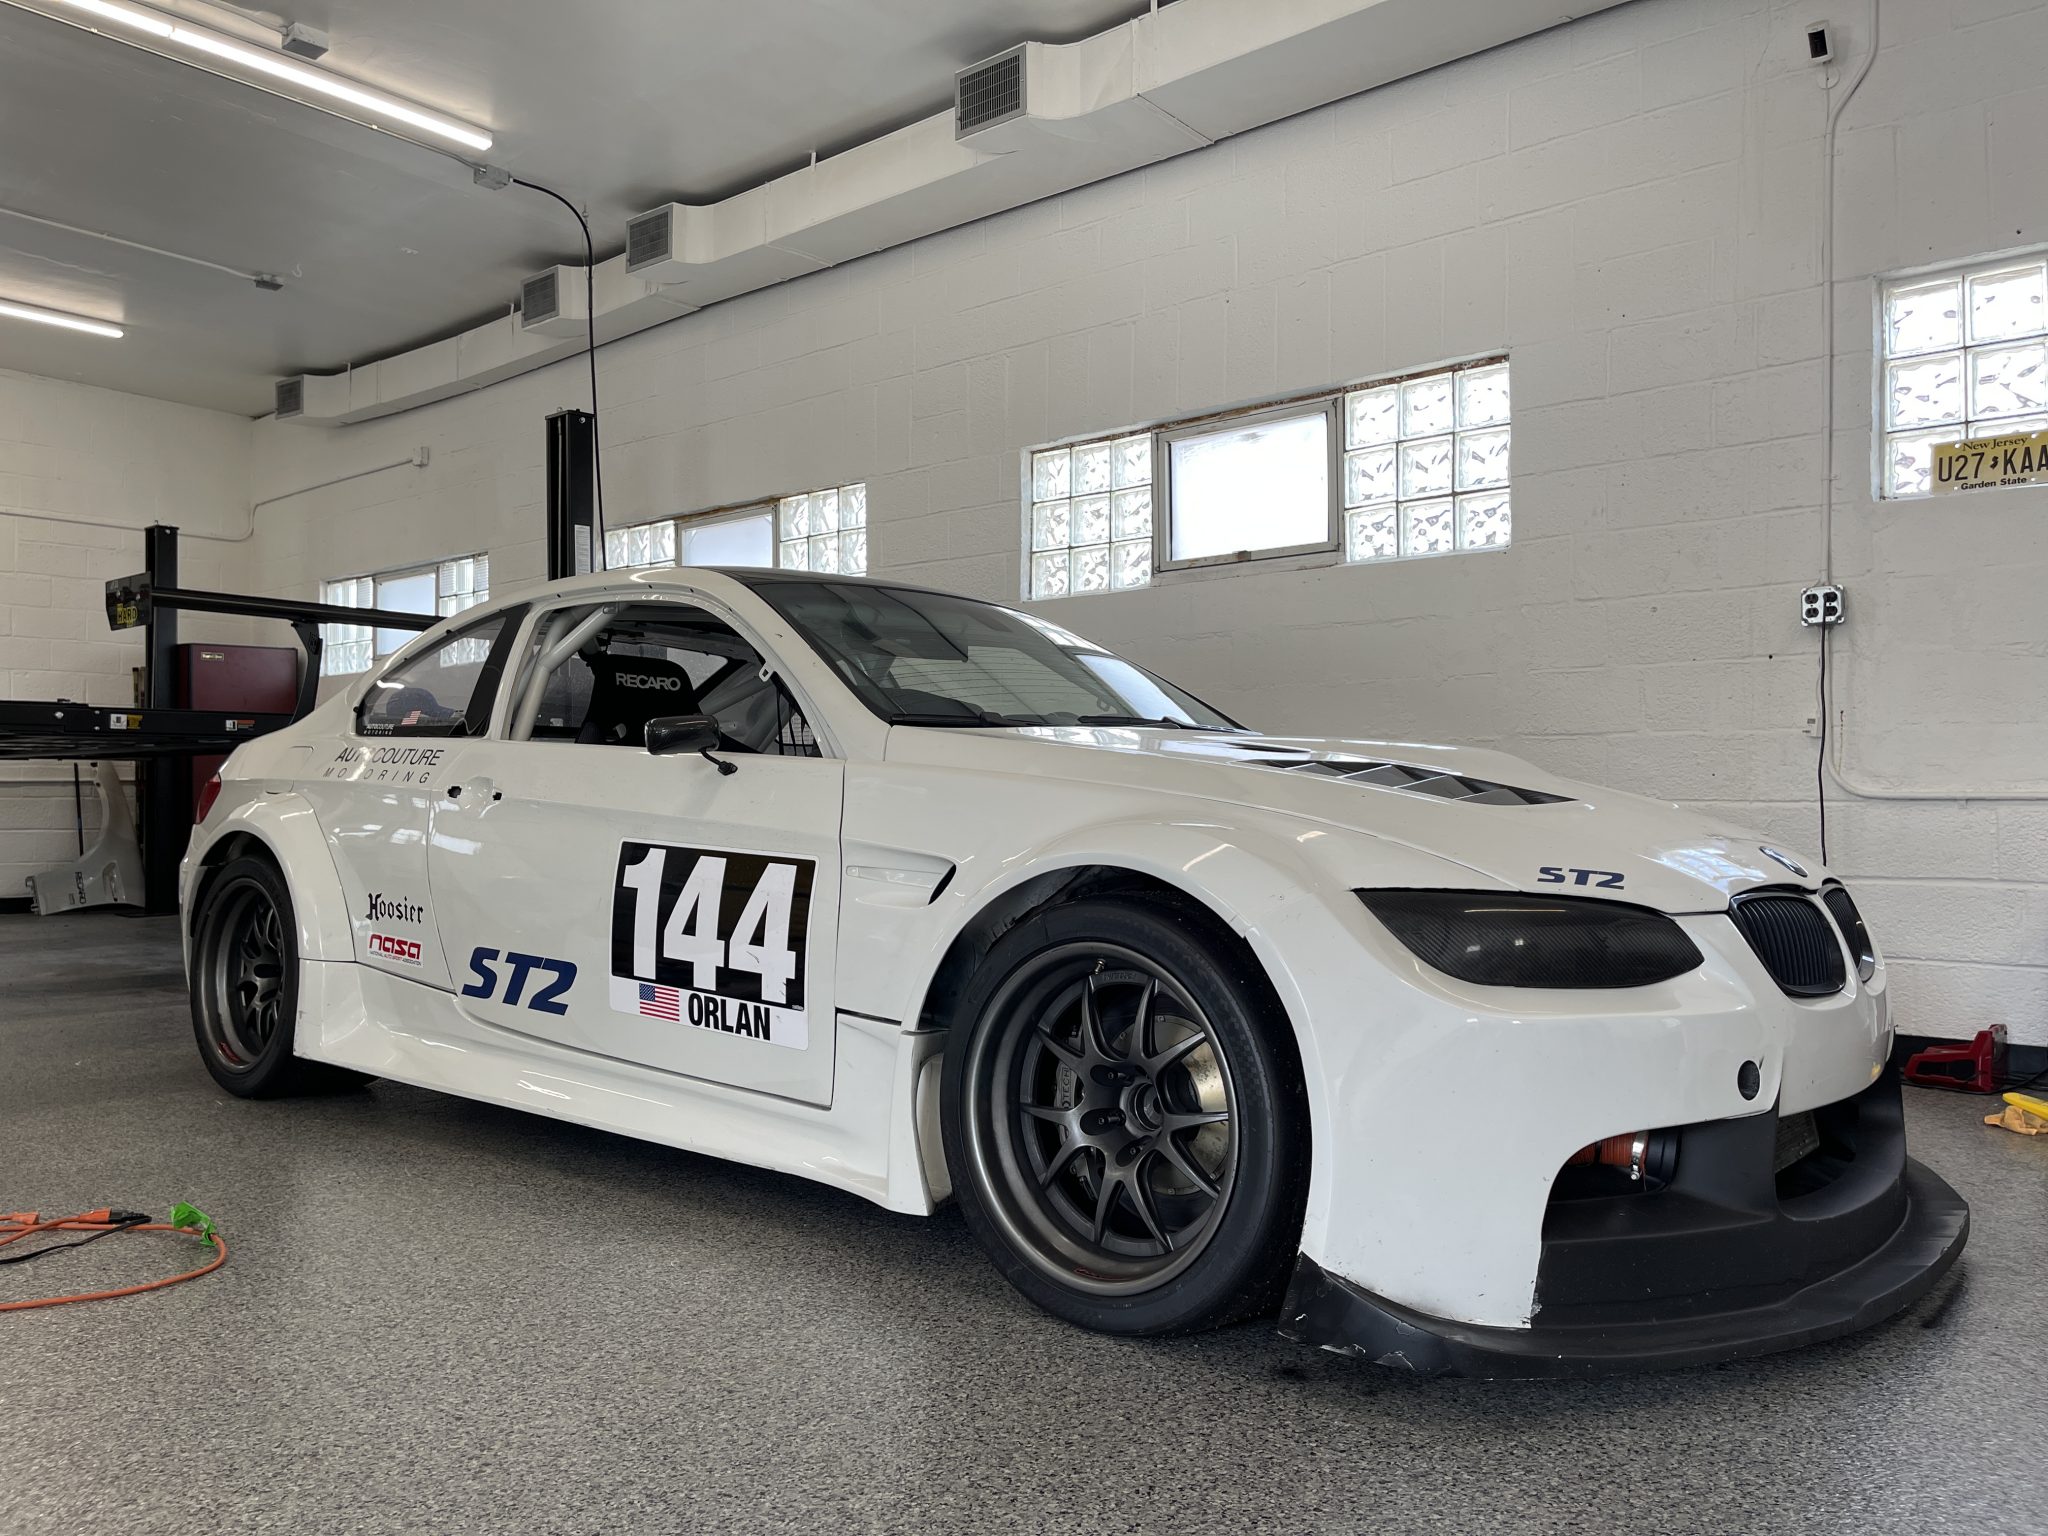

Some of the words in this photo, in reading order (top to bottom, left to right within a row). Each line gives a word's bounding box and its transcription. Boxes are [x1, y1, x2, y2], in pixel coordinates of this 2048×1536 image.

[1963, 442, 1990, 451] New
[1991, 436, 2028, 449] Jersey
[1938, 452, 1985, 482] U27
[2003, 444, 2048, 475] KAA
[1961, 480, 1996, 490] Garden
[2000, 476, 2027, 485] State
[616, 672, 681, 691] RECARO
[335, 747, 445, 766] AUTCOUTURE
[323, 767, 430, 784] MOORING
[74, 871, 86, 905] RECARO
[1537, 866, 1625, 890] ST2
[366, 892, 424, 925] Hoosier
[623, 847, 798, 1004] 144
[462, 947, 577, 1015] ST2
[688, 992, 771, 1041] ORLAN
